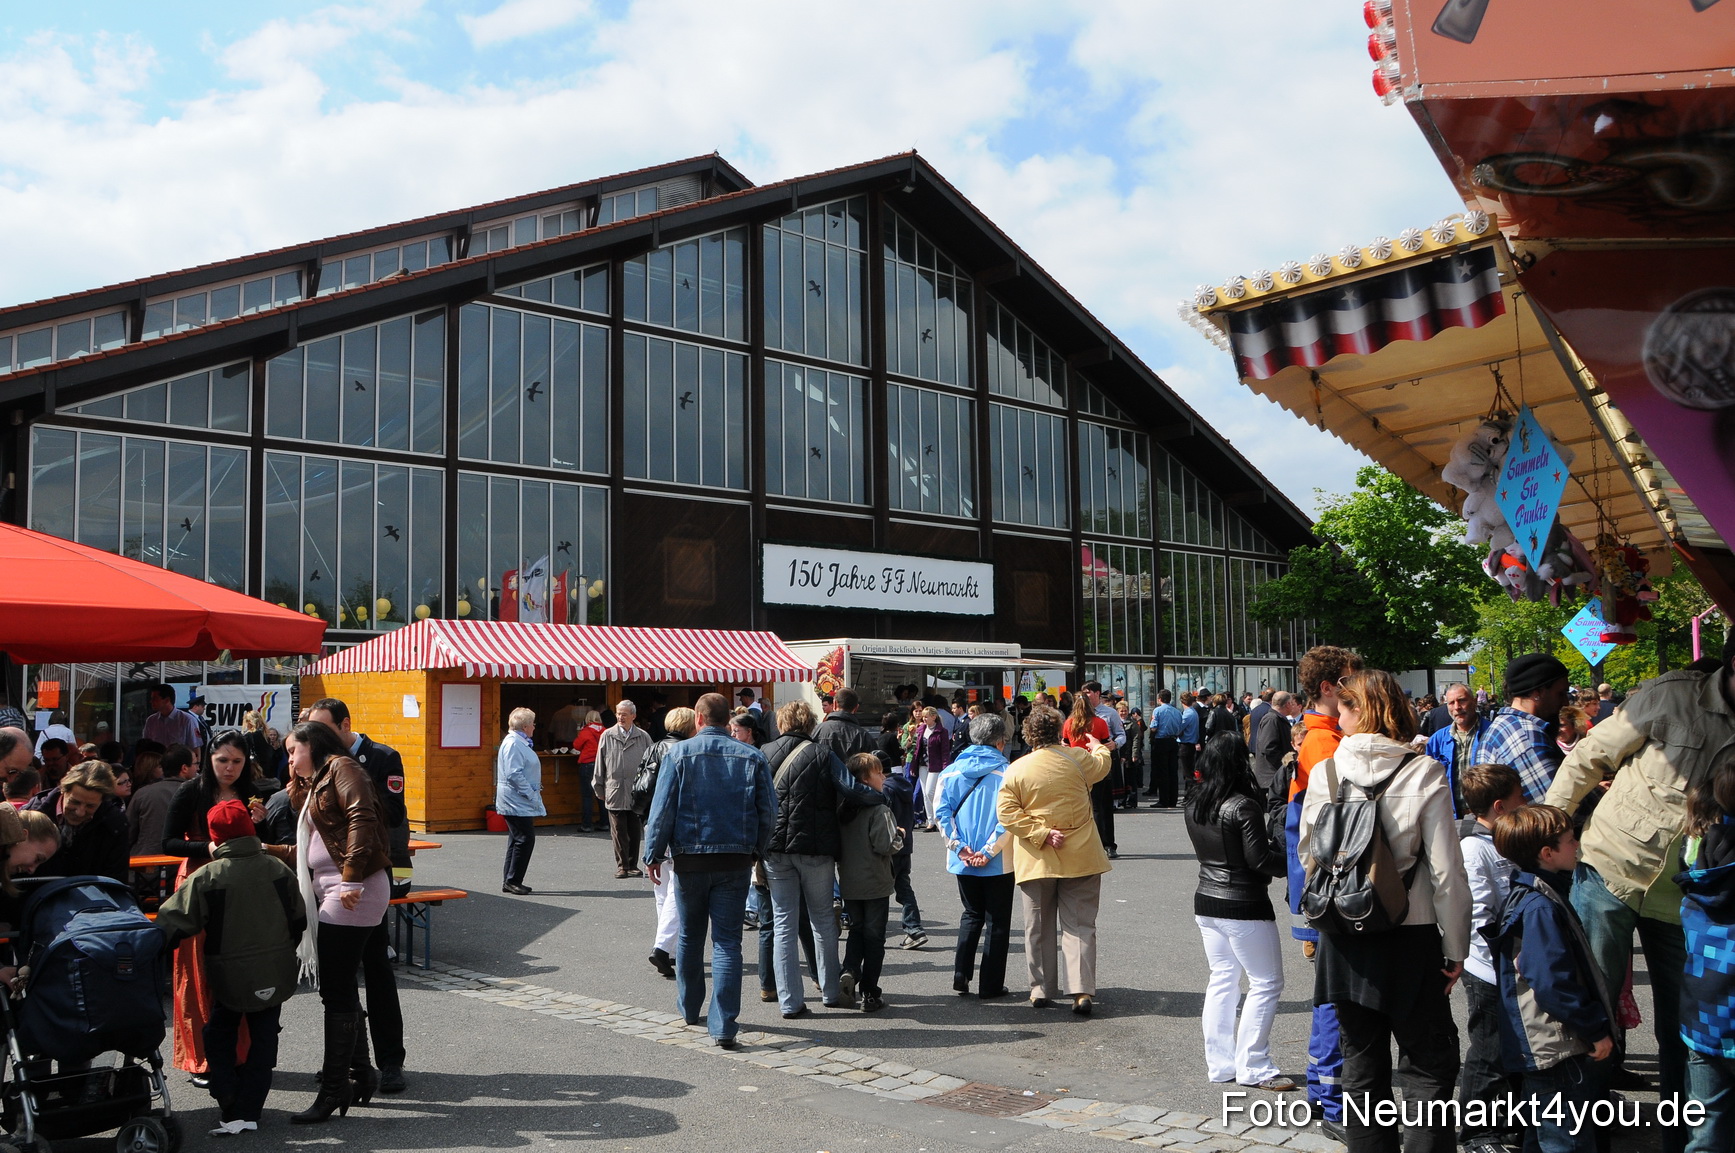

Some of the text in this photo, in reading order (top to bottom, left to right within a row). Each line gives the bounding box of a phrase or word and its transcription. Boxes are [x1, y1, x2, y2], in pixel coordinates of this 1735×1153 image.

[1507, 444, 1549, 480] Sammeln
[1520, 476, 1539, 501] Sie
[1515, 499, 1549, 528] Punkte
[788, 558, 824, 588] 150
[826, 562, 876, 598] Jahre
[906, 571, 980, 599] Neumarkt
[861, 644, 888, 654] Original
[888, 645, 917, 654] Backfisch
[973, 647, 1009, 656] Lachssemmel
